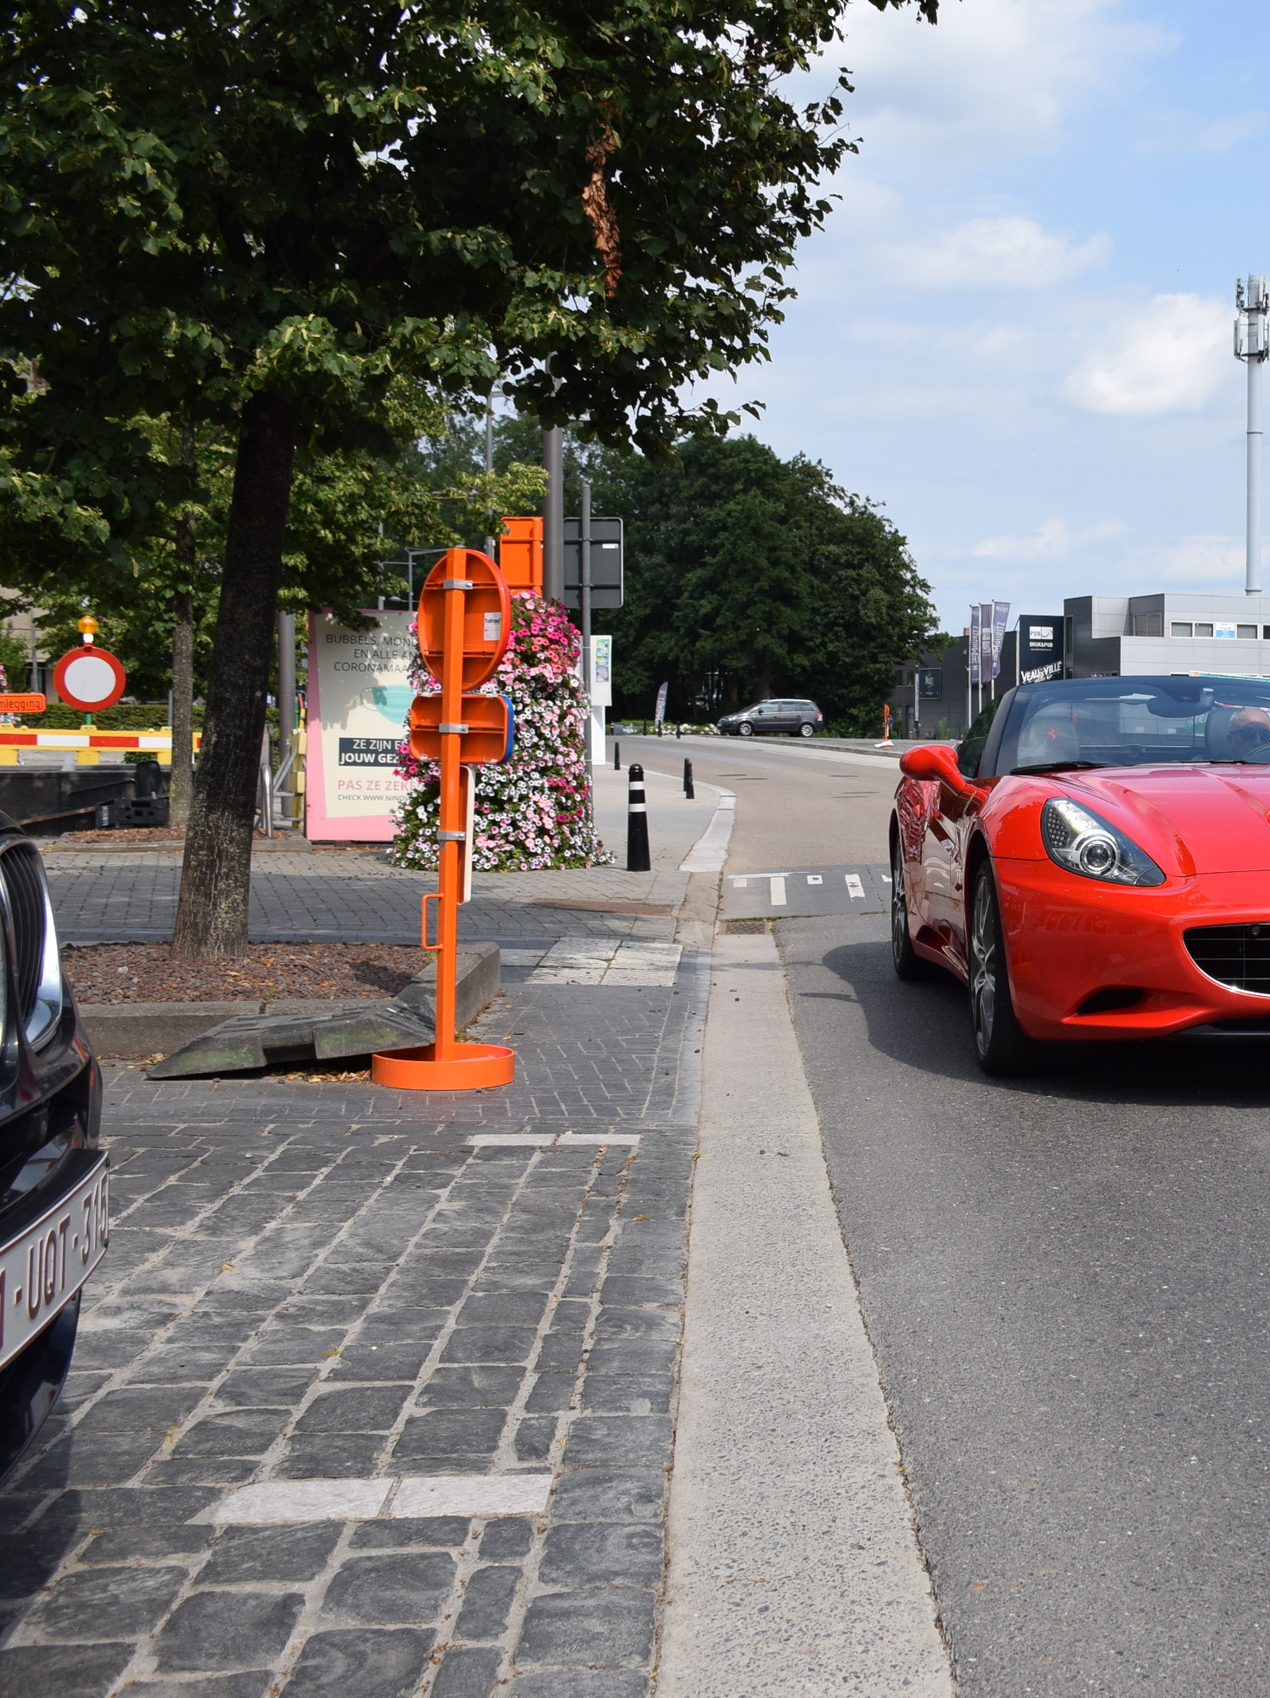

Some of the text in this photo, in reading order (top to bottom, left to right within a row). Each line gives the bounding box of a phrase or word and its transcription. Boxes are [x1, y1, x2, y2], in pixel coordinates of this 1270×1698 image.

[326, 634, 379, 646] BUBBELS,
[354, 649, 369, 658] EN
[372, 650, 398, 659] ALLE
[353, 739, 366, 749] ZE
[369, 740, 391, 751] ZIJN
[340, 753, 375, 764] JOUW
[338, 780, 362, 790] PAS
[366, 780, 381, 791] ZE
